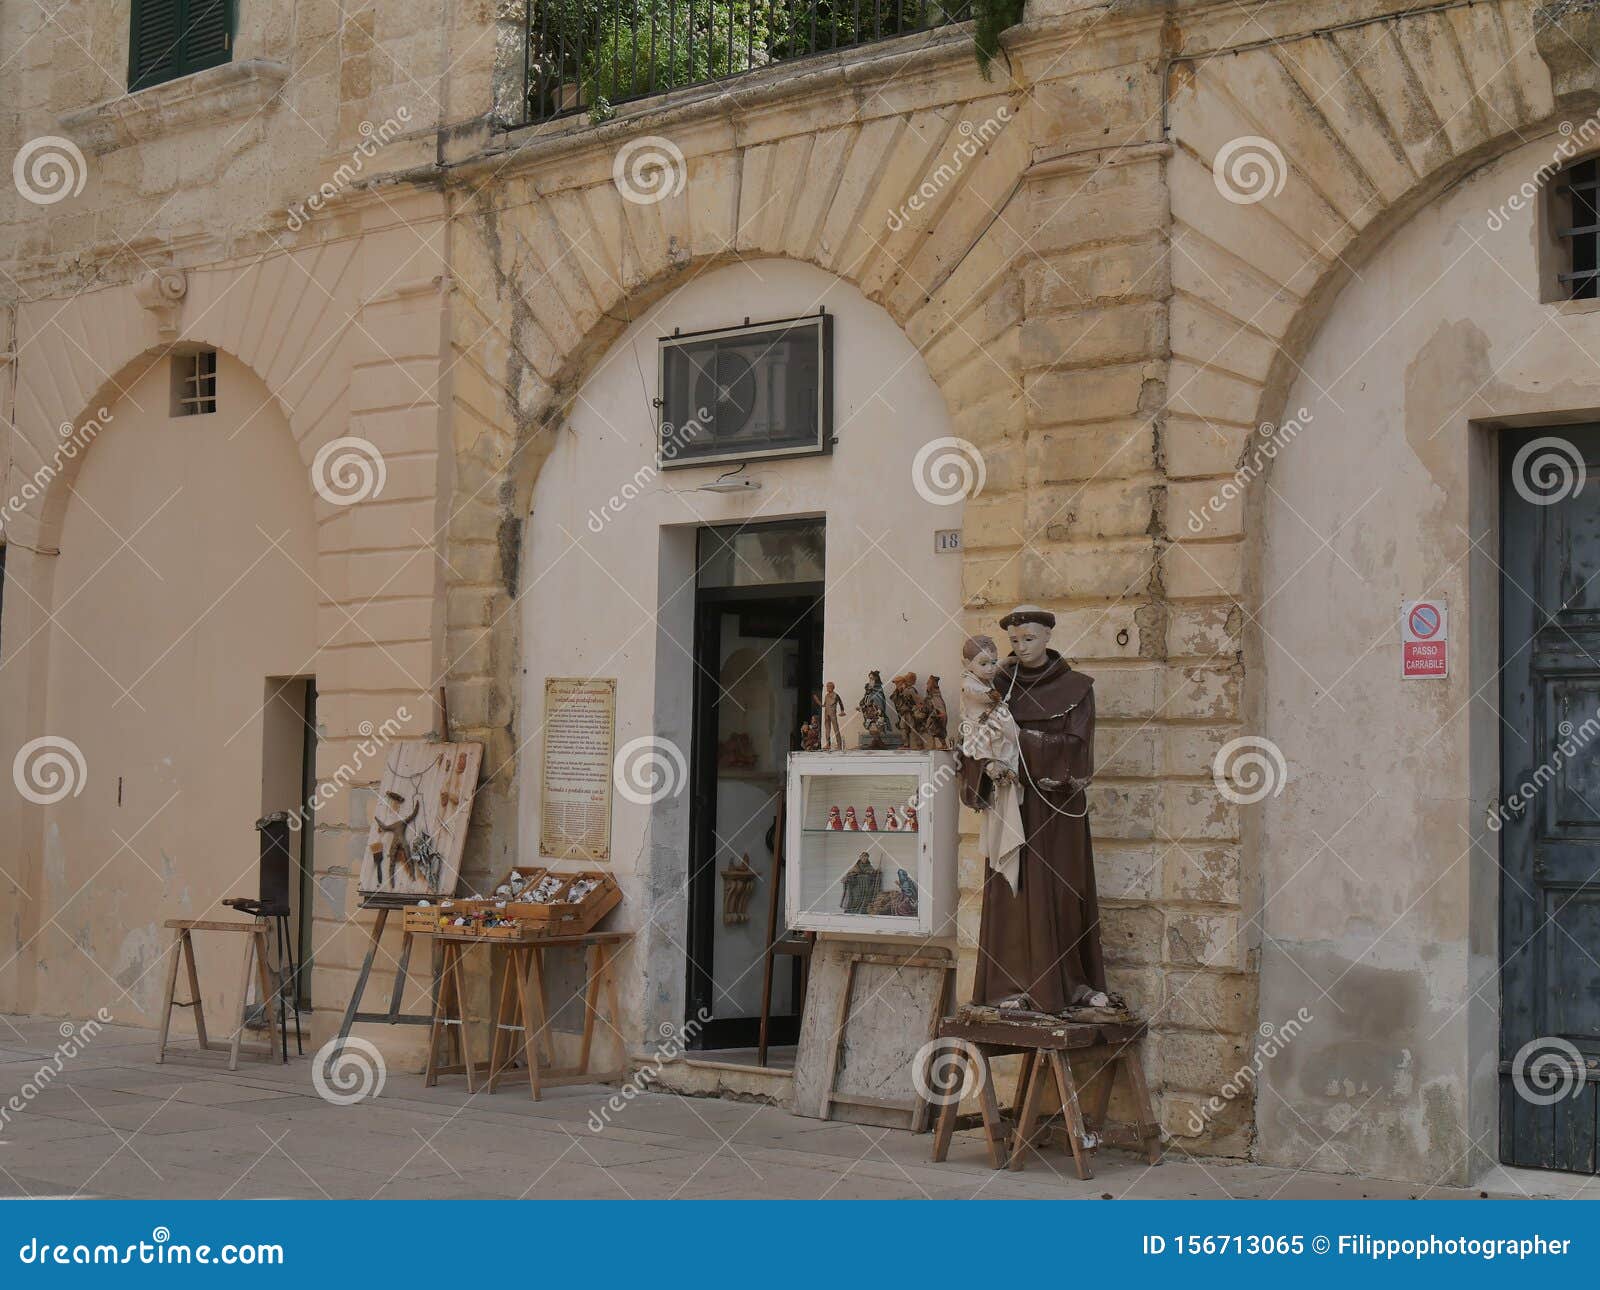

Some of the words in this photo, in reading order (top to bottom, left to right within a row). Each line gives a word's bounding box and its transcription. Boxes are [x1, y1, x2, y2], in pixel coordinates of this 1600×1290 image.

[942, 533, 958, 548] 18
[1412, 646, 1437, 656] PASSO
[1406, 659, 1444, 670] CARRABILE
